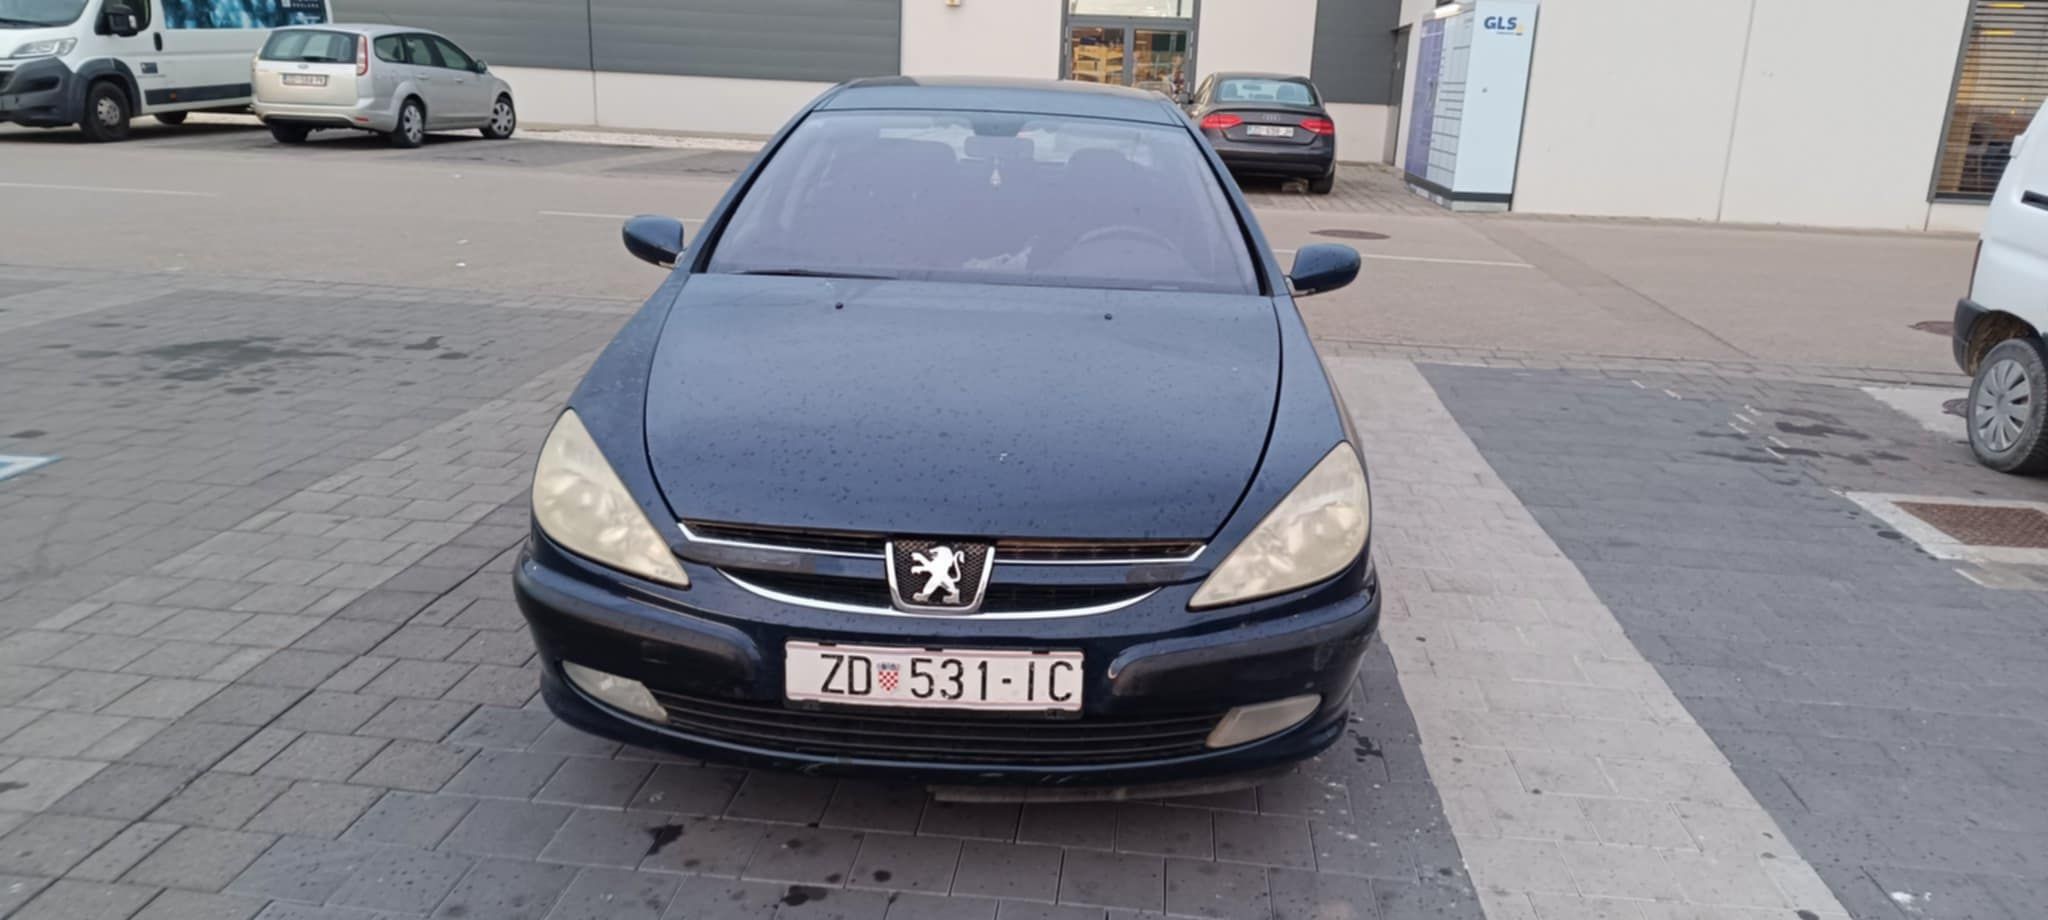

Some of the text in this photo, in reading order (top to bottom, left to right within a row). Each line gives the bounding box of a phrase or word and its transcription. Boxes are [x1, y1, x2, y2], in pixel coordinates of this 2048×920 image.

[1484, 16, 1517, 30] GLS
[820, 653, 1073, 702] ZD 531-IC
